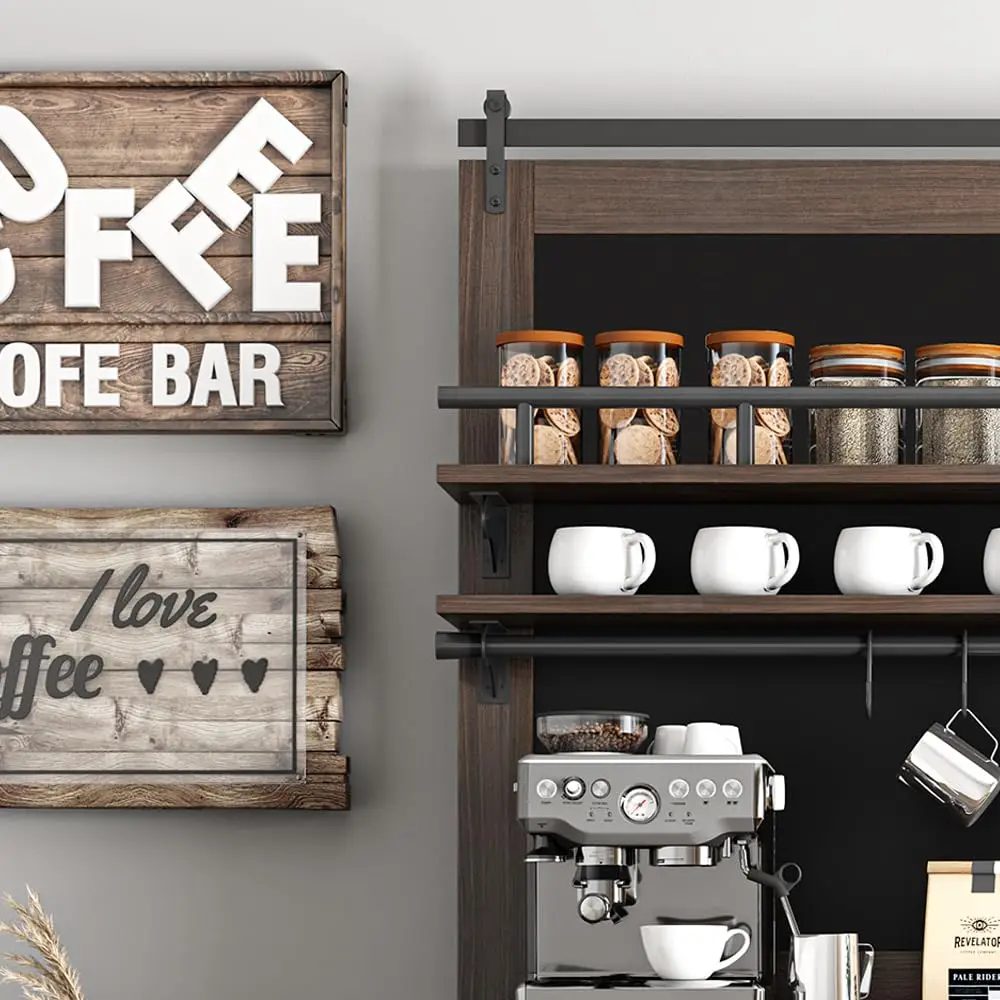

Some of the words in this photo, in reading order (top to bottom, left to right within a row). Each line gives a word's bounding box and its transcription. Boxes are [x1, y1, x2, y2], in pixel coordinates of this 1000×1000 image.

[0, 97, 322, 312] OFFEE
[152, 342, 285, 407] BAR
[112, 563, 218, 629] love
[0, 634, 104, 720] ffee
[953, 973, 974, 981] PALE
